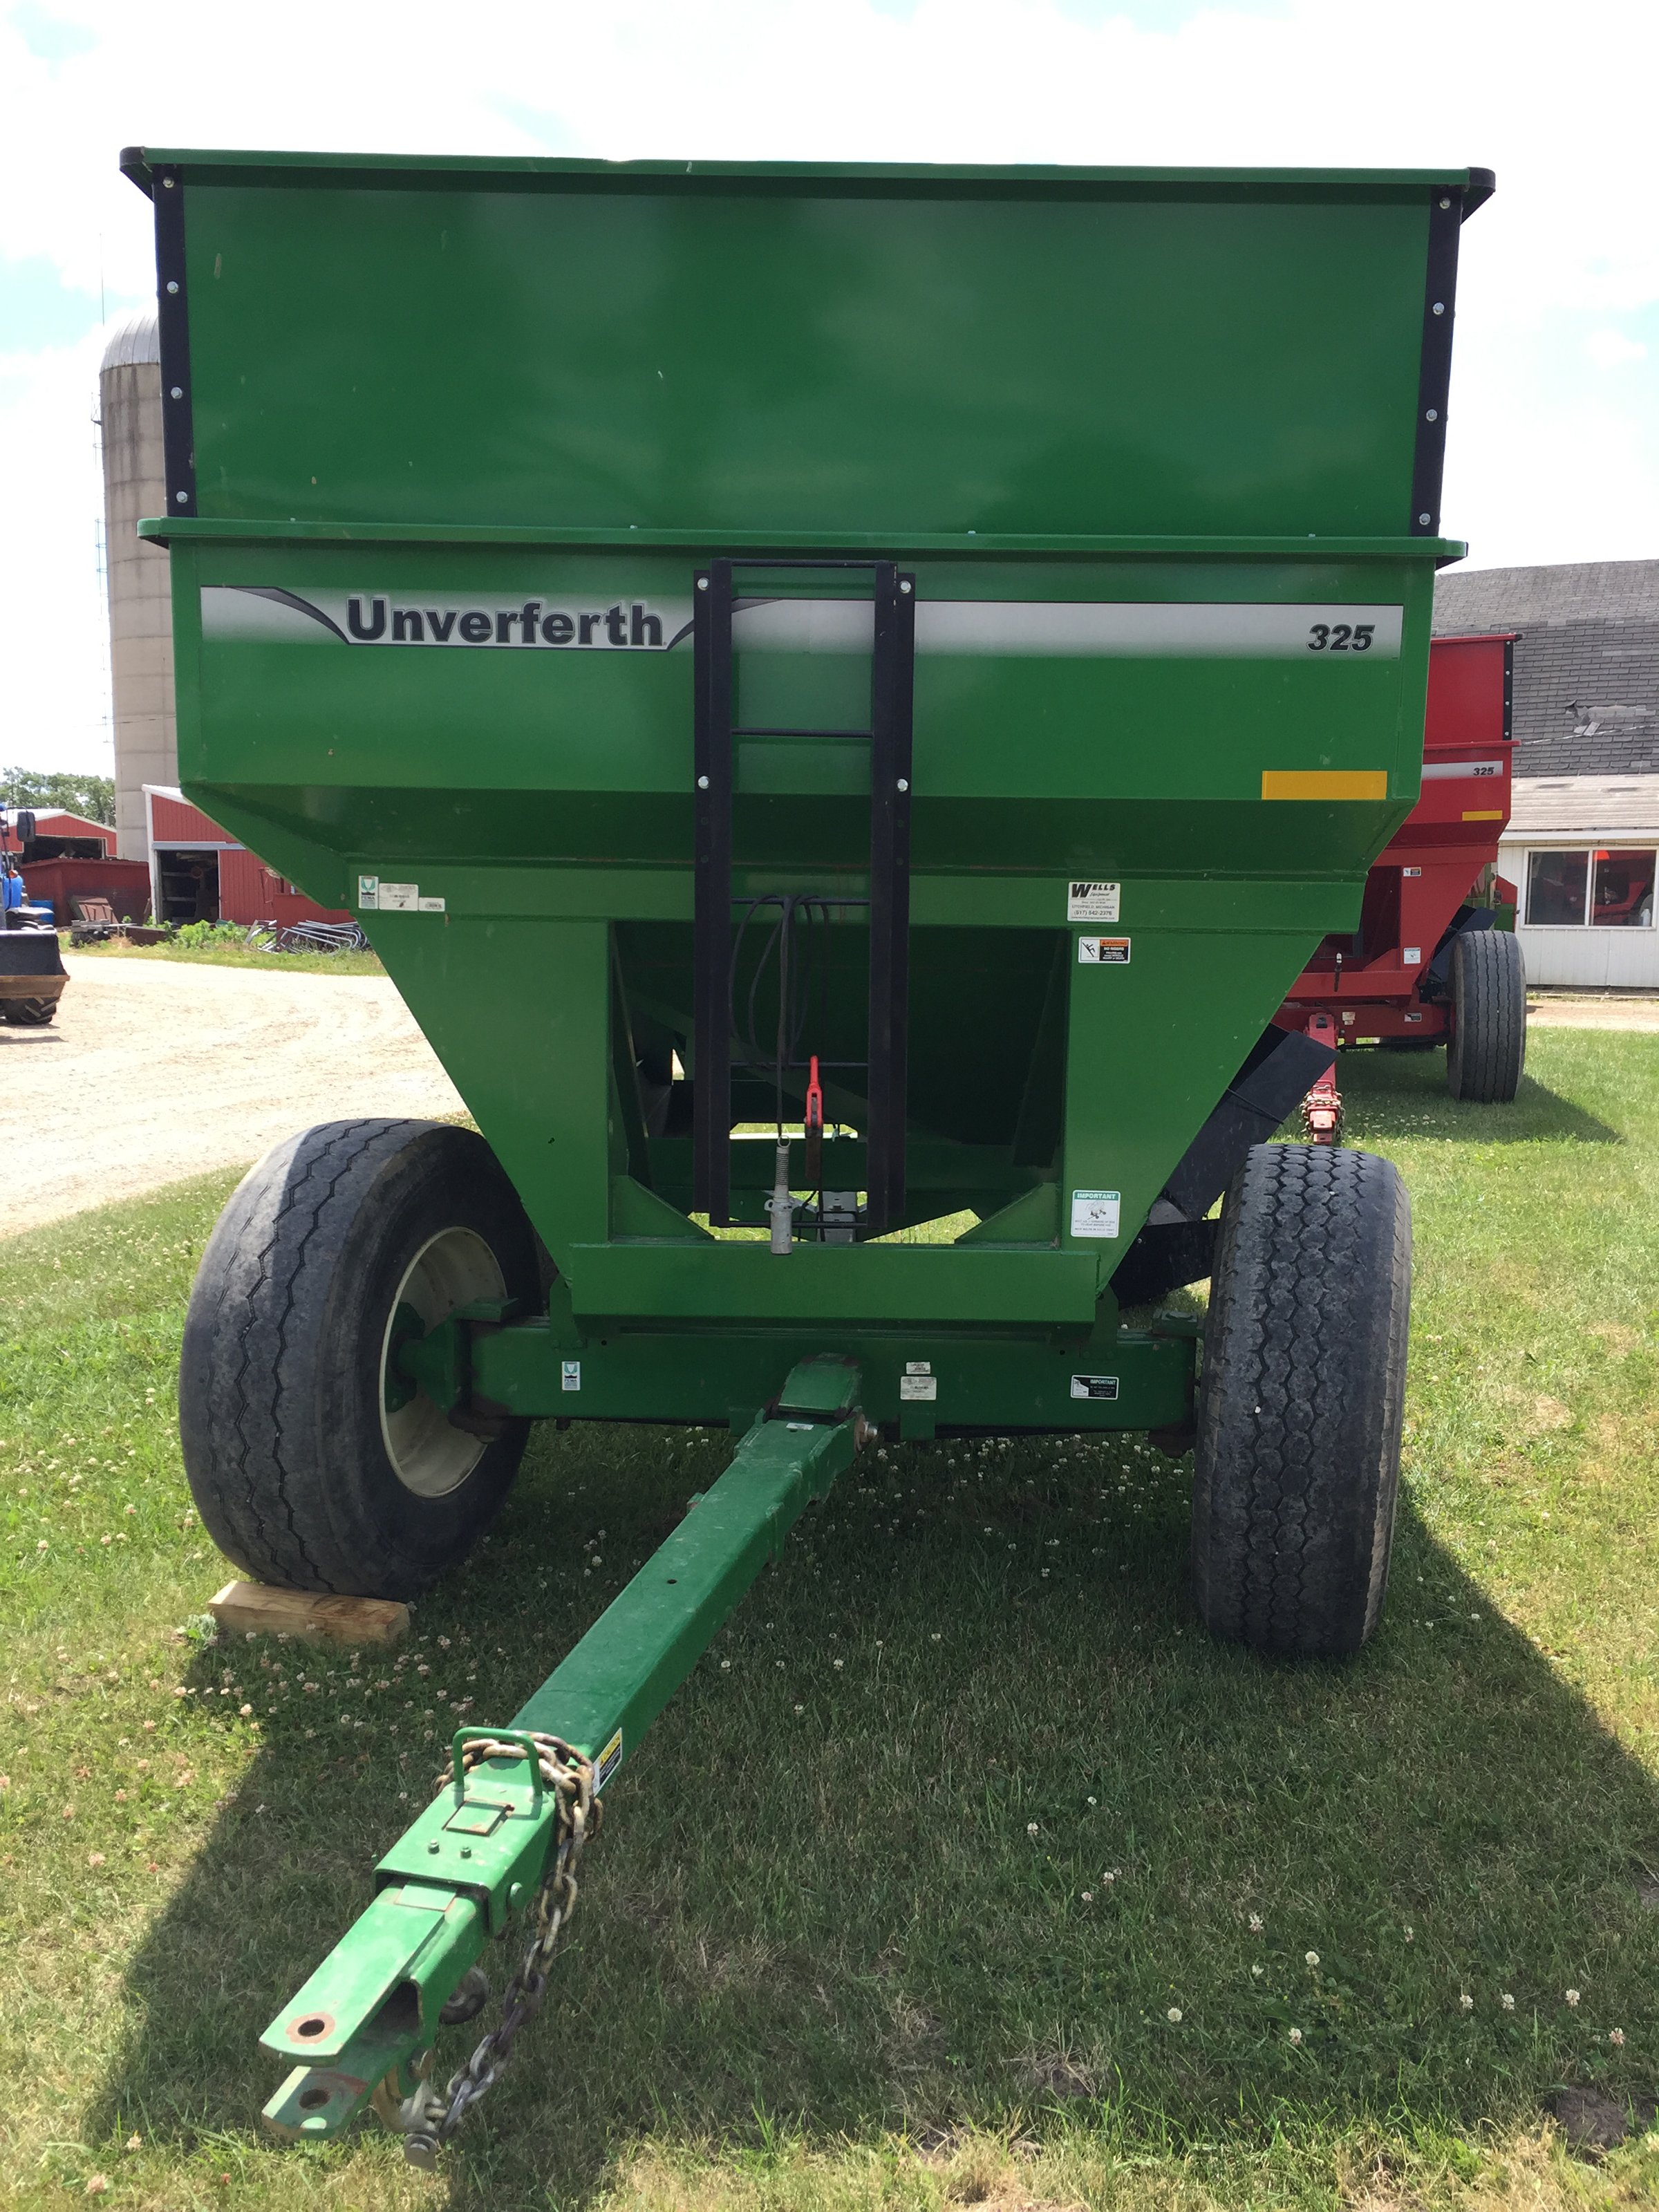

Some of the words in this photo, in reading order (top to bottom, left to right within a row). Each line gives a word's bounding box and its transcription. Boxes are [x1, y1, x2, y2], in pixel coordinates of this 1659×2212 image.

[347, 597, 664, 646] Unverferth
[1306, 624, 1376, 652] 325
[1473, 767, 1494, 776] 325
[1072, 883, 1116, 898] WELLS
